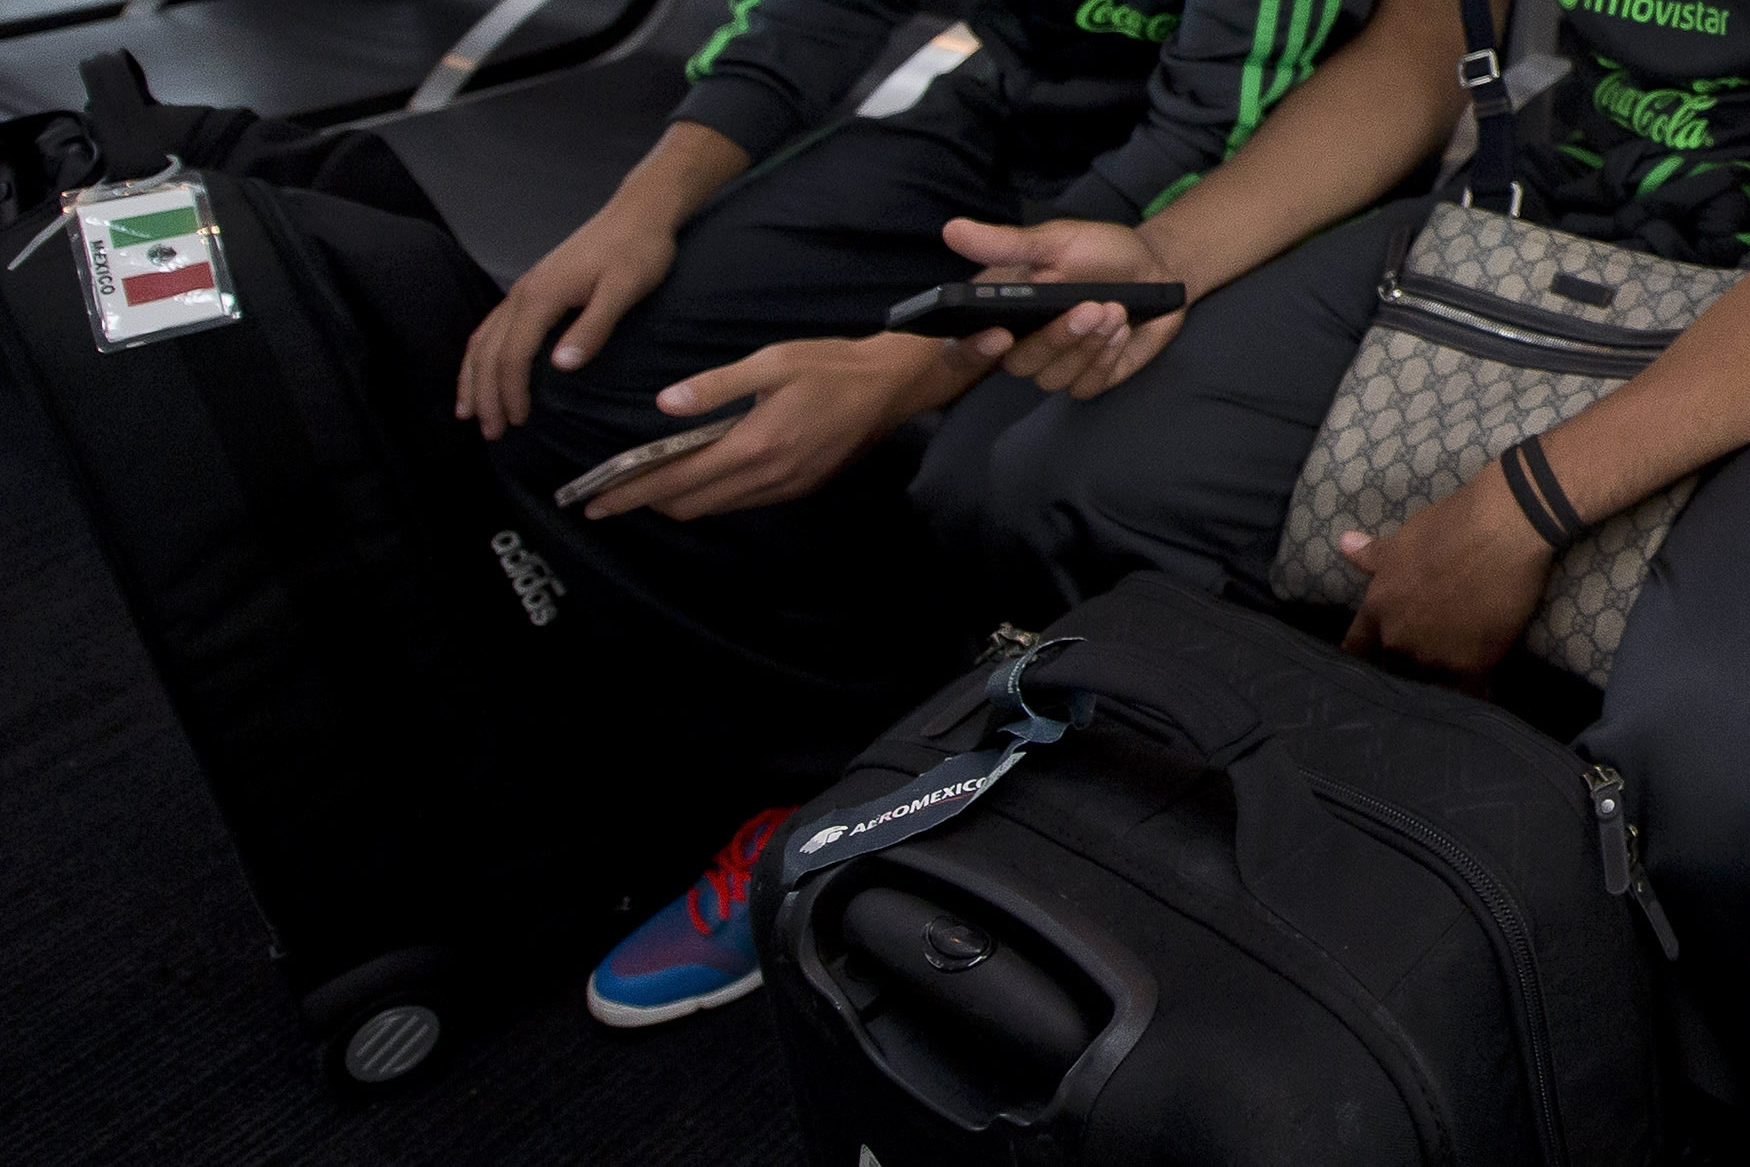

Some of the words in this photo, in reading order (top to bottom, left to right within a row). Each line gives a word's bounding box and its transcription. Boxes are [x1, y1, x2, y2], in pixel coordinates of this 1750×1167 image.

[91, 239, 116, 295] MEXICO
[490, 529, 558, 627] adidas
[849, 776, 988, 837] AEROMEXICO
